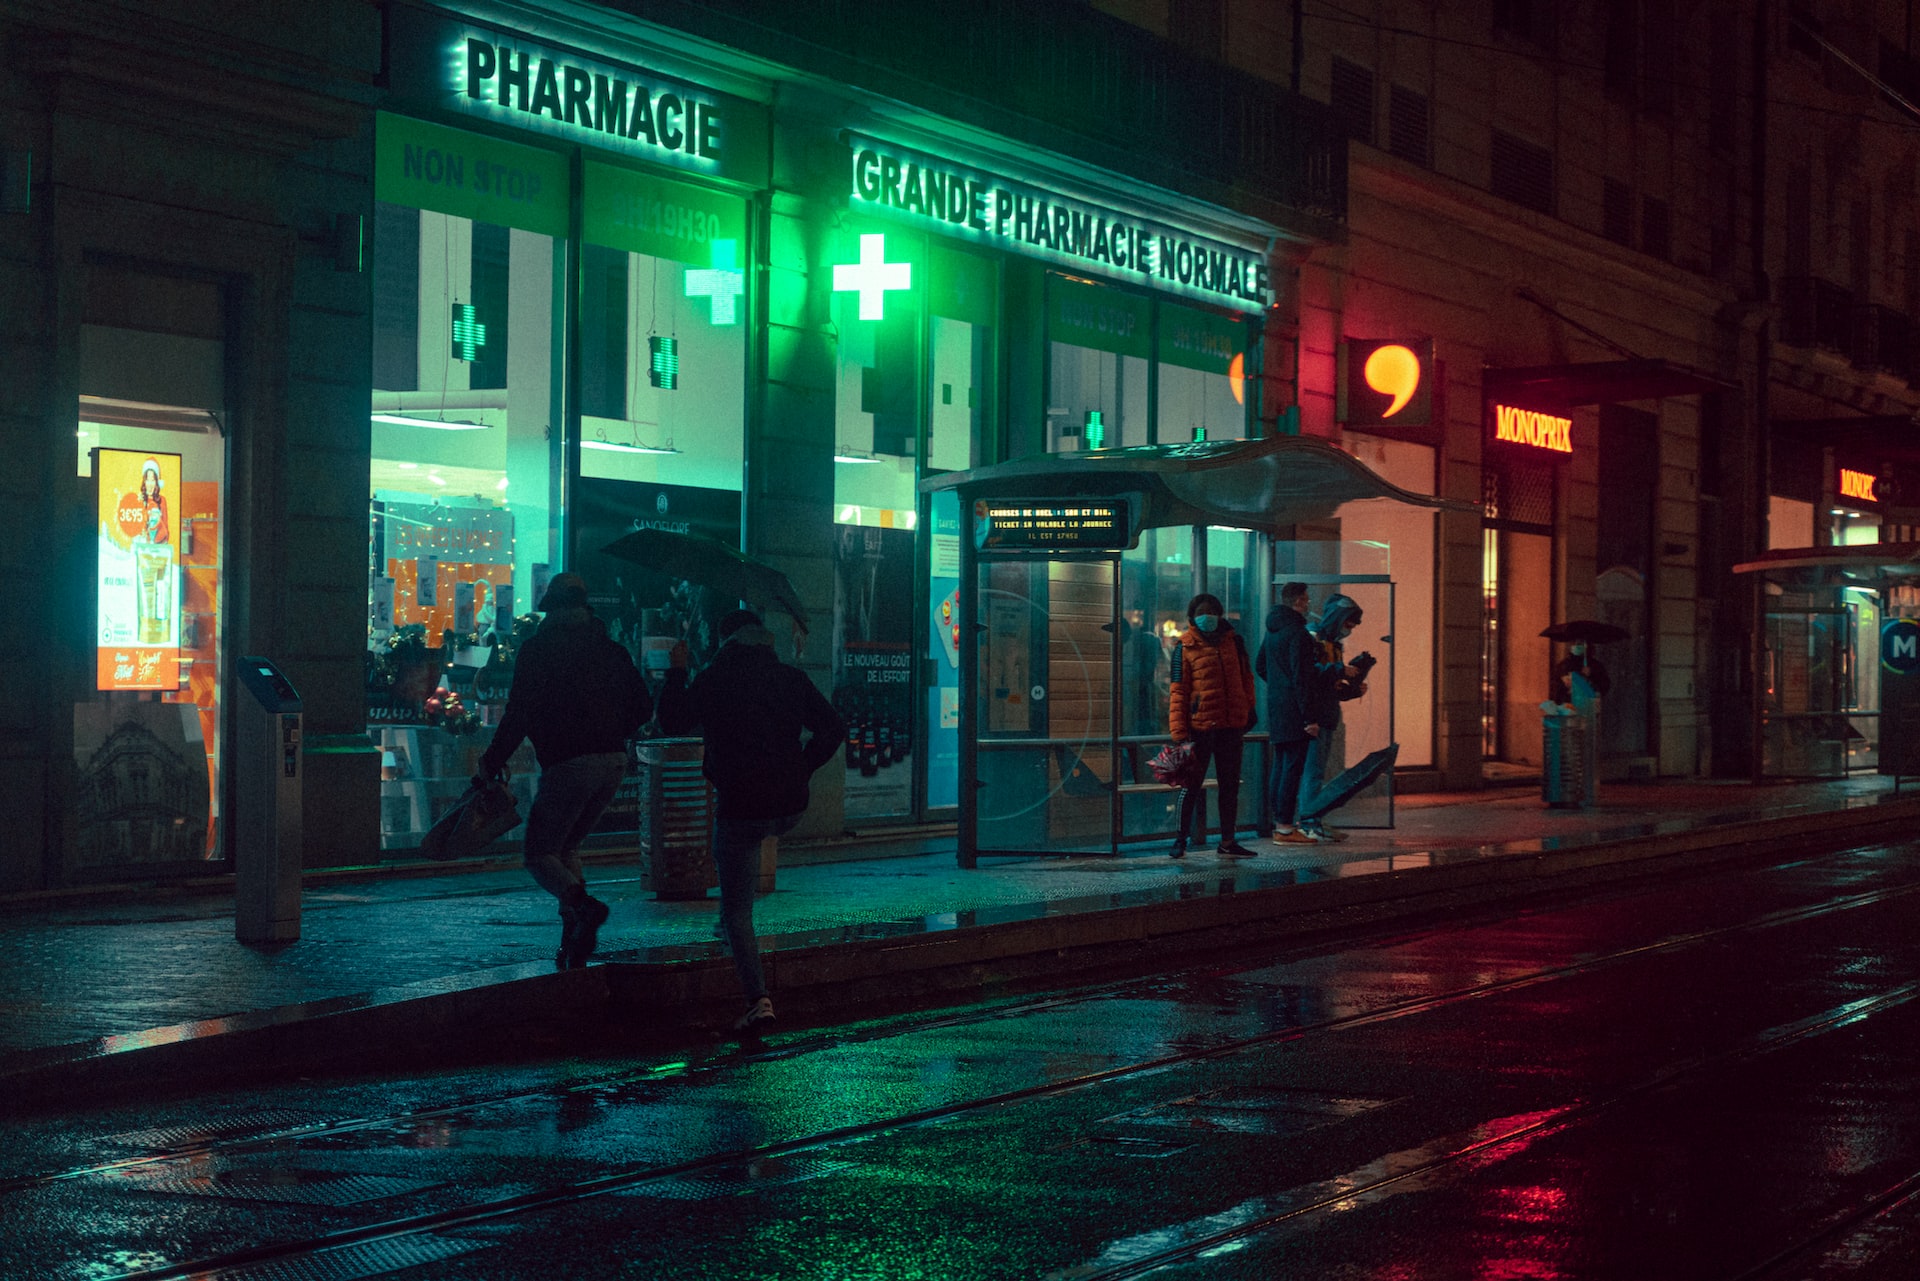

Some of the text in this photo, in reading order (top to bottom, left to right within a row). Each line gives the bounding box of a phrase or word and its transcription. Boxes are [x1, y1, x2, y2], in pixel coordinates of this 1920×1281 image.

[467, 37, 722, 161] PHARMACIE
[404, 143, 543, 205] NON STOP
[857, 149, 1269, 305] GRANDE PHARMACIE NORMALE
[1098, 306, 1136, 337] STOP
[1496, 404, 1573, 453] MONOPRIX
[119, 507, 144, 524] 3€95
[843, 654, 854, 667] LE
[854, 654, 889, 667] NOUVEAU
[1892, 635, 1916, 658] M
[867, 670, 877, 683] DE
